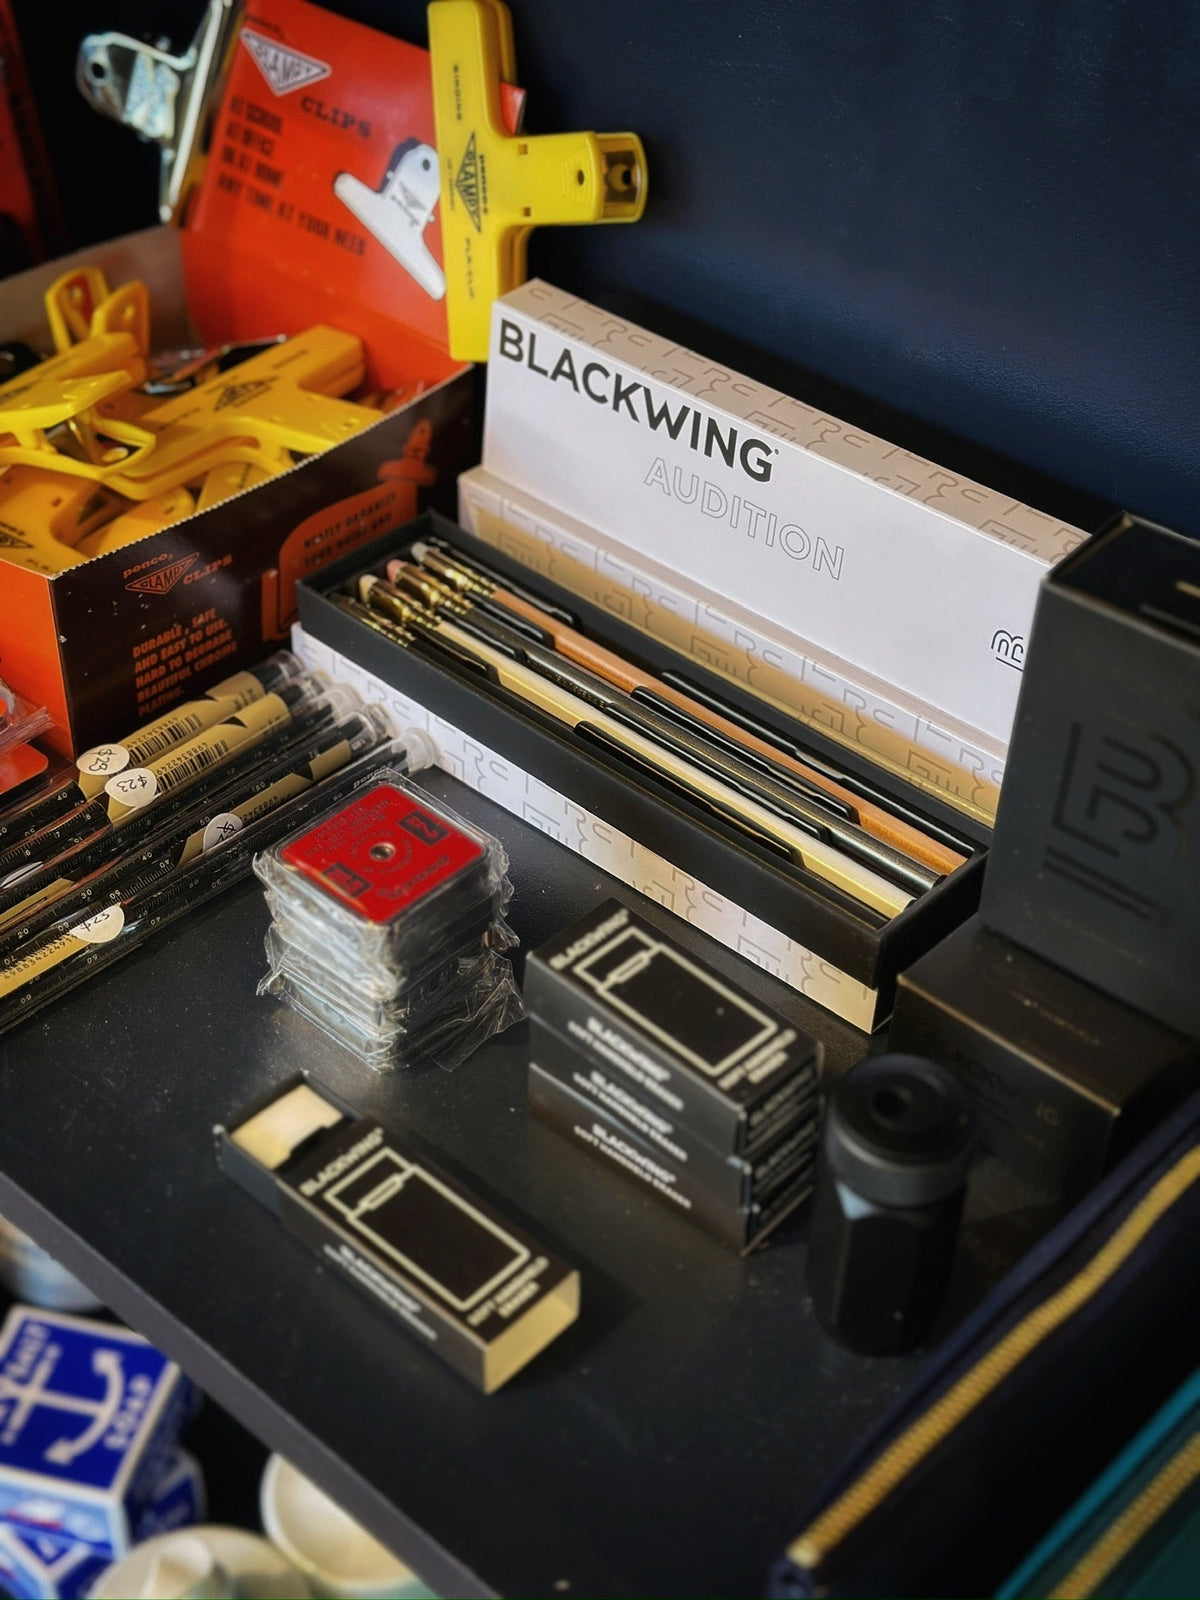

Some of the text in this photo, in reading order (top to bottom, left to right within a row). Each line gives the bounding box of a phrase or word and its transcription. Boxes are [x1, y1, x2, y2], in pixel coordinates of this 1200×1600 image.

[301, 96, 371, 138] CLIPS
[499, 318, 774, 483] BLACKWING
[644, 456, 845, 581] AUDITION
[122, 552, 168, 579] penco
[183, 554, 233, 585] CLIPS
[191, 608, 217, 631] SAFE
[134, 655, 159, 676] AND
[160, 640, 189, 663] EASY
[189, 631, 204, 647] TO
[135, 669, 167, 691] HARD
[168, 660, 184, 677] TO
[117, 775, 148, 793] $23
[159, 858, 170, 869] 40
[17, 928, 30, 939] 20
[80, 889, 93, 900] 30
[142, 851, 153, 862] 40
[109, 889, 121, 900] 50
[4, 956, 17, 966] 70
